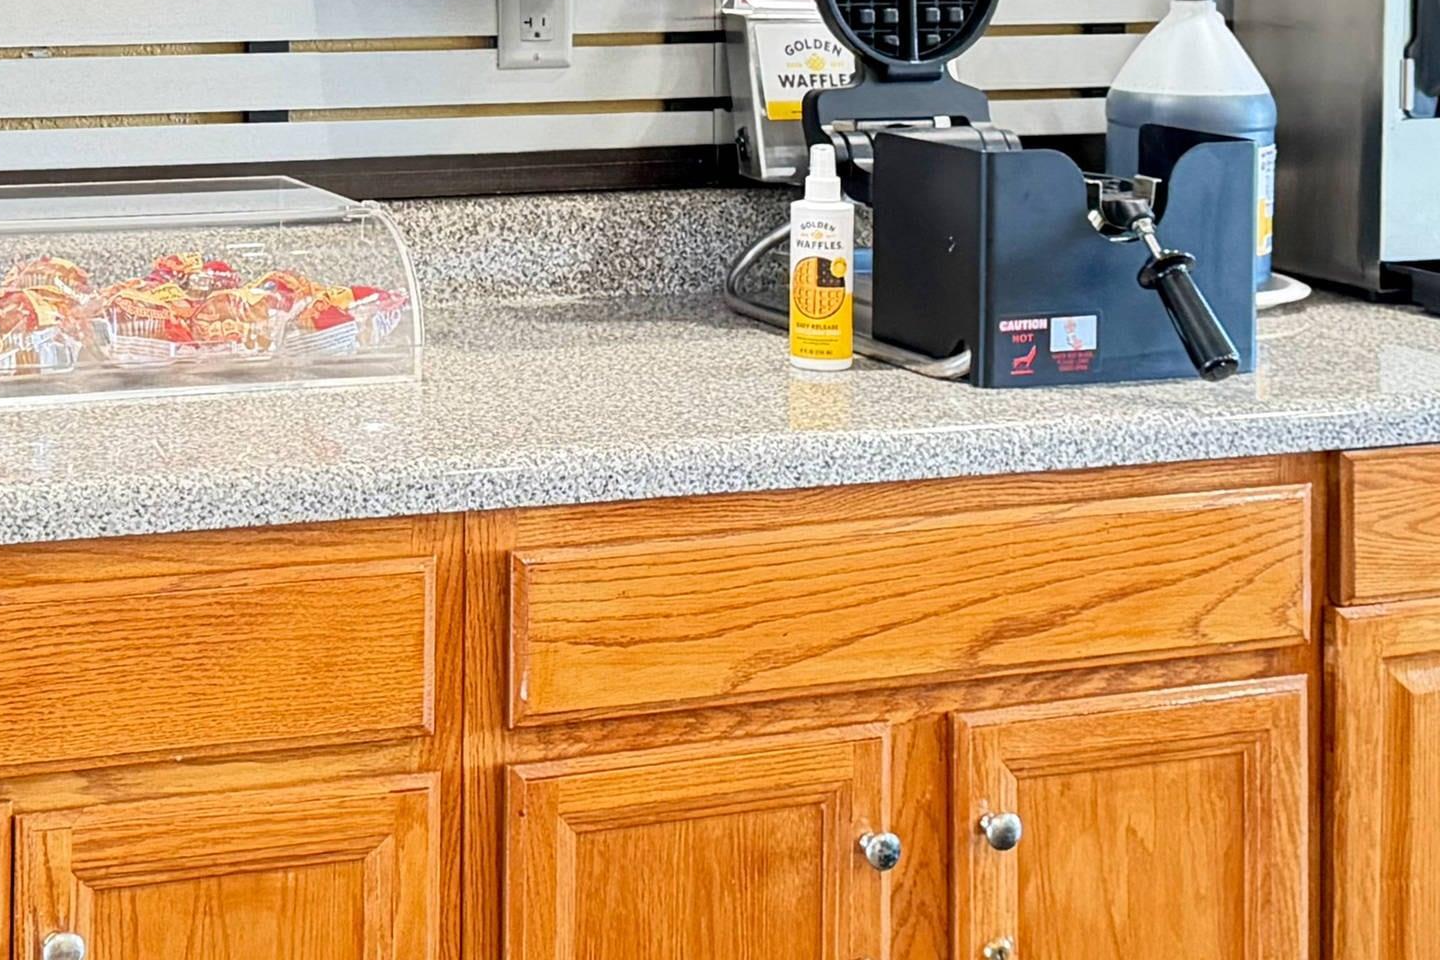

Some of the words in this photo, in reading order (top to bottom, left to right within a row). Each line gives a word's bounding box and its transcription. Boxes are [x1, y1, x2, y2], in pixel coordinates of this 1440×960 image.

[785, 39, 842, 56] GOLDEN
[800, 221, 837, 232] GOLDEN
[796, 239, 842, 250] WAFFLES
[999, 318, 1048, 332] CAUTION
[1012, 333, 1034, 343] HOT
